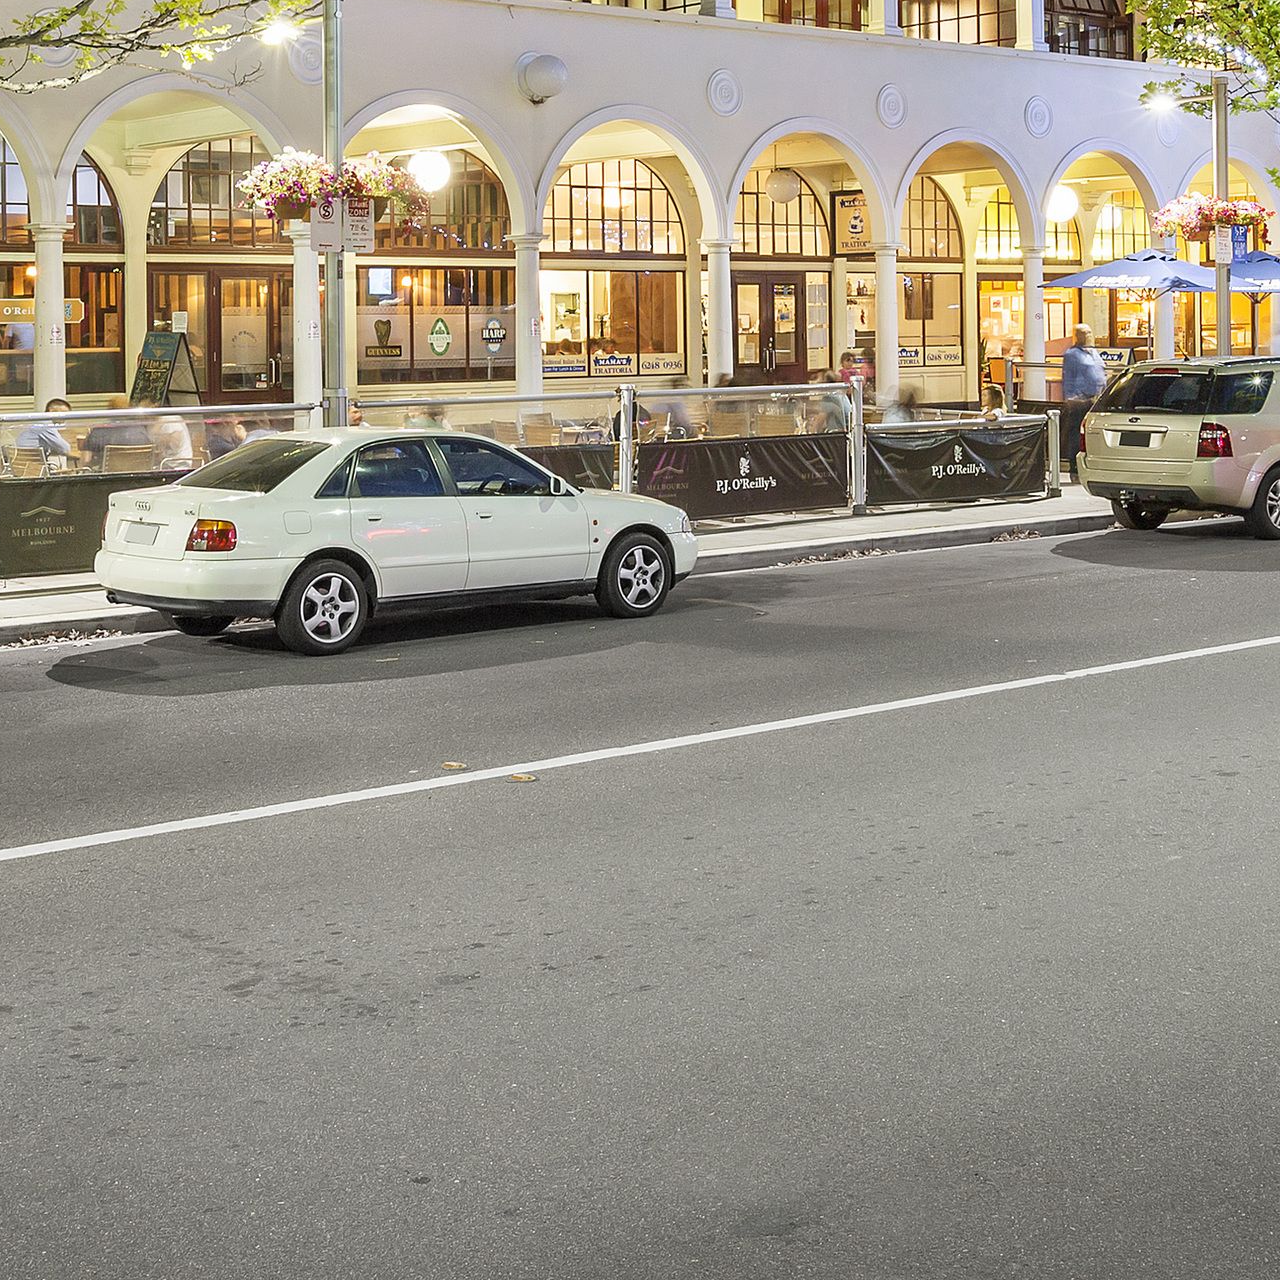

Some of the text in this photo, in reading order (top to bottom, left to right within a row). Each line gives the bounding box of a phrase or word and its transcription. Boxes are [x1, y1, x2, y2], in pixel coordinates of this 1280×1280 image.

[349, 208, 369, 217] ZONE
[3, 306, 35, 316] O'Reil
[482, 329, 506, 339] HARP
[367, 347, 401, 356] GUINNESS
[598, 358, 627, 366] MAMA'S
[641, 360, 682, 370] 6248 0936
[594, 367, 633, 375] TRATTORIA
[932, 463, 986, 479] P.J. O'Reilly's
[646, 482, 689, 491] MELBOURNE
[716, 477, 777, 494] P.J. O'Reilly's
[11, 524, 76, 538] MELBOURNE
